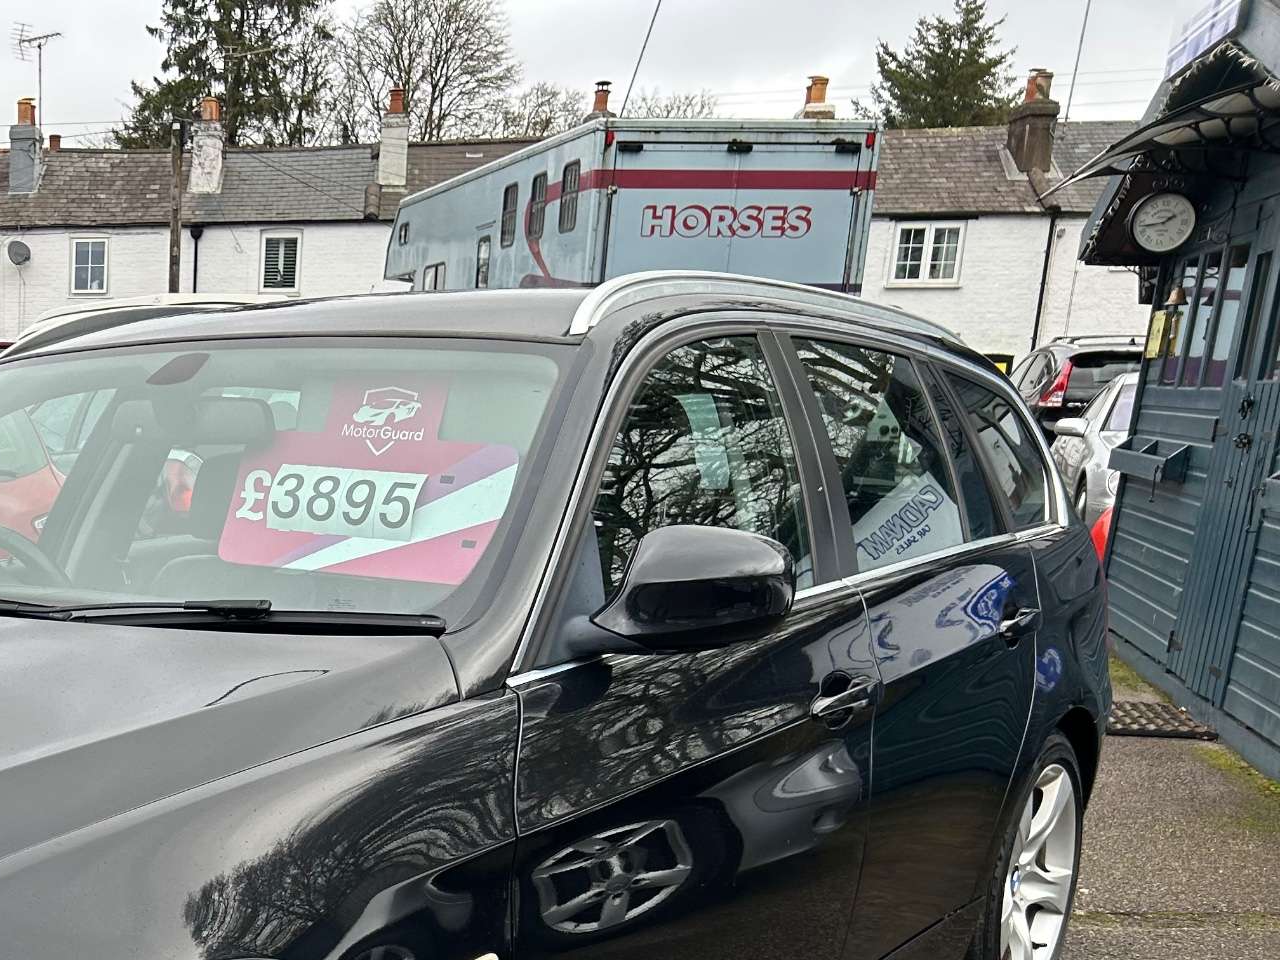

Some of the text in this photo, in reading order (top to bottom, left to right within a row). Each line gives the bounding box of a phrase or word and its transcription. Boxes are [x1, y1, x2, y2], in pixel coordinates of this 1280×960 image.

[640, 204, 812, 239] HORSES
[341, 423, 425, 442] MotorGuard
[235, 469, 417, 529] £3895
